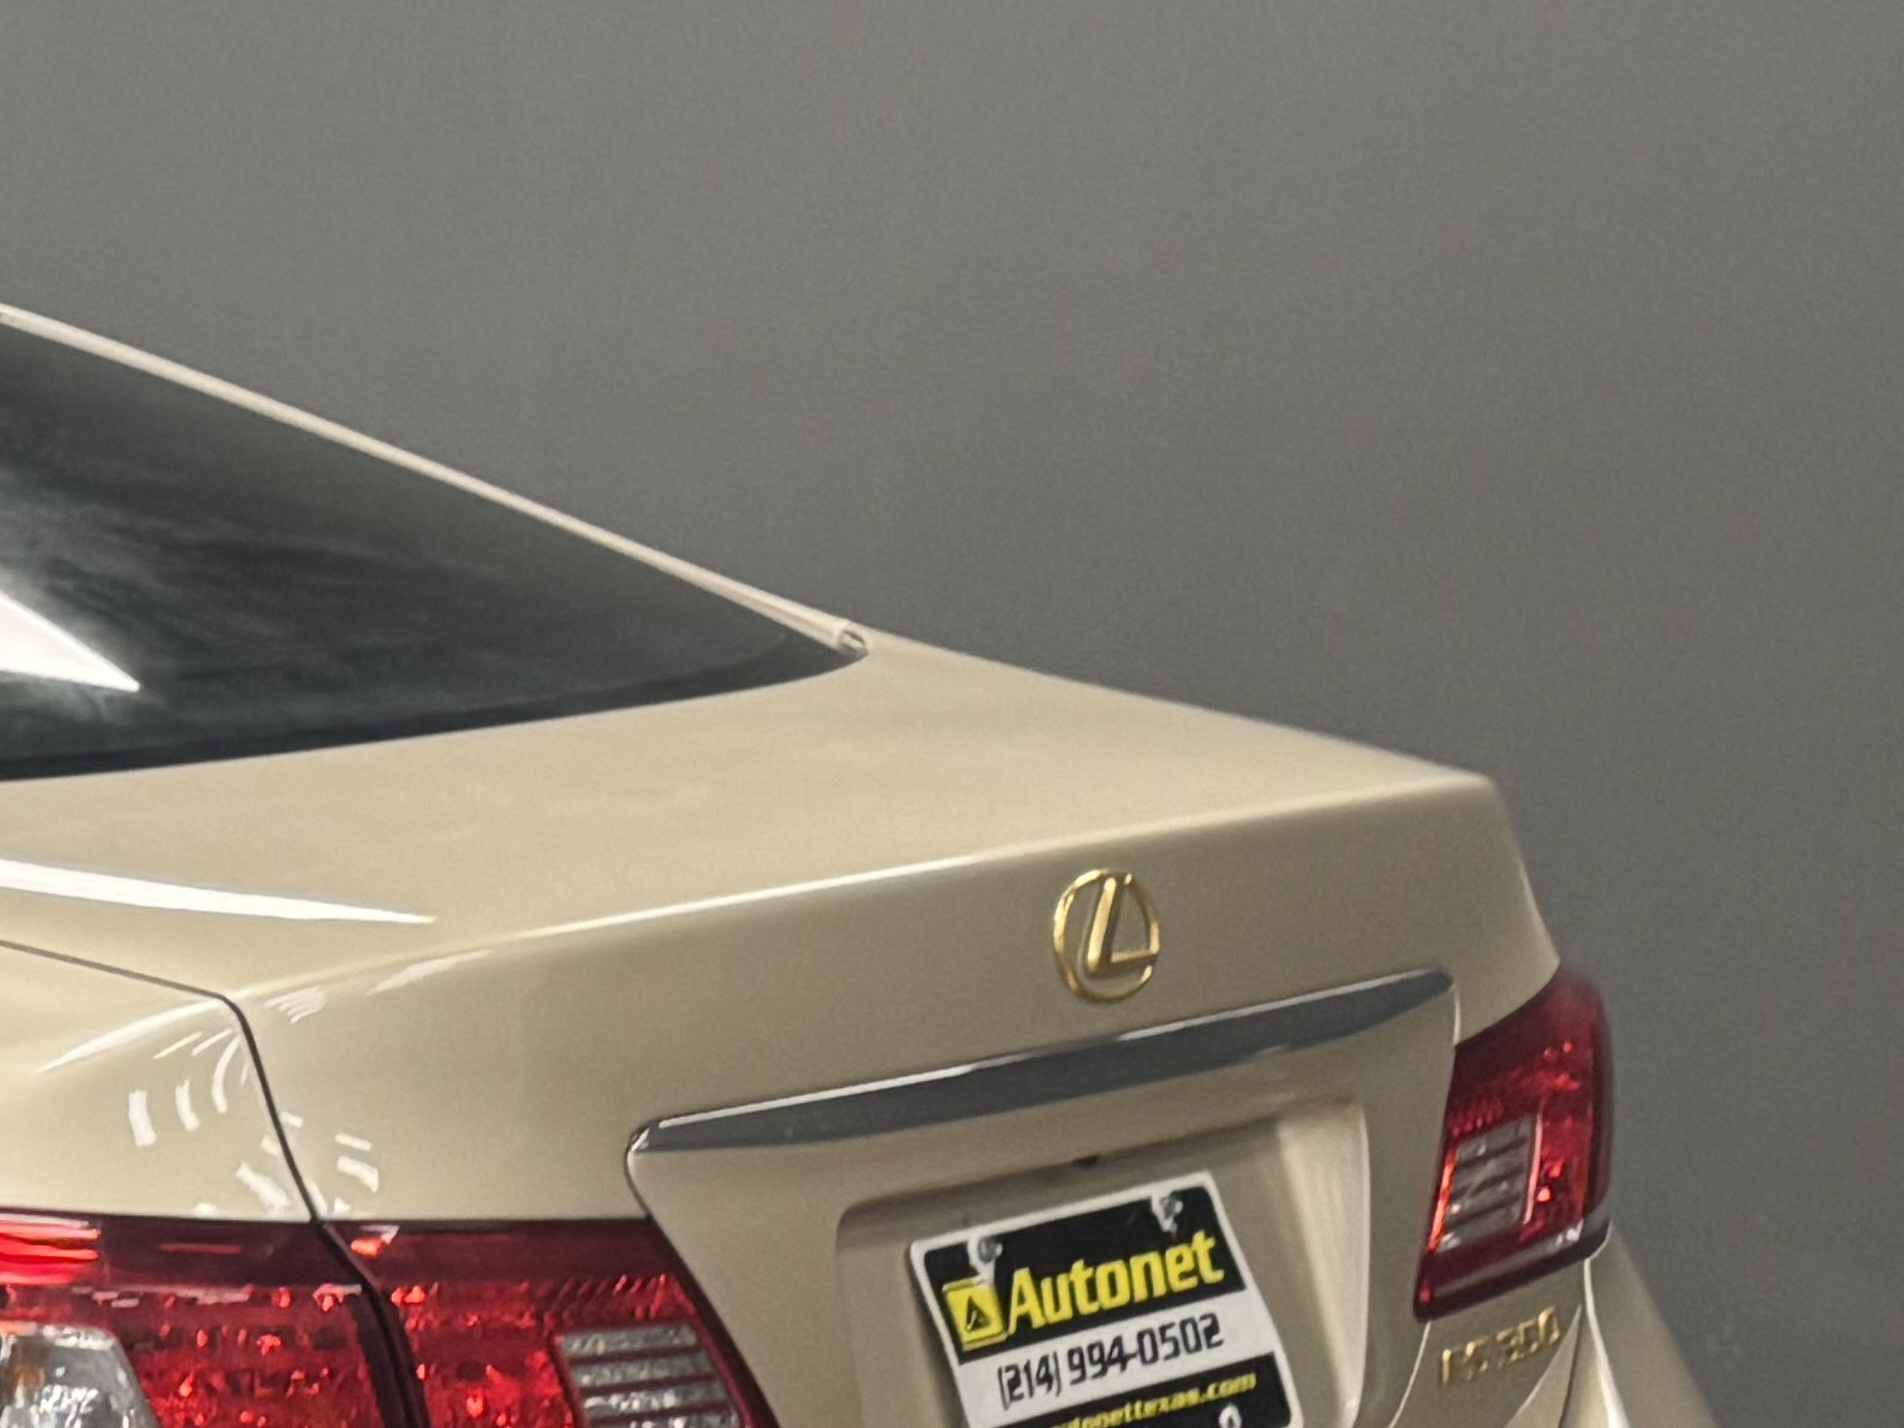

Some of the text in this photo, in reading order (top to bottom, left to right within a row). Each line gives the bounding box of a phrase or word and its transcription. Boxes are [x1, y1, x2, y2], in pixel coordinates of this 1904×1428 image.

[1007, 1229, 1225, 1335] Autonet
[997, 1312, 1225, 1410] (214) 994-0502
